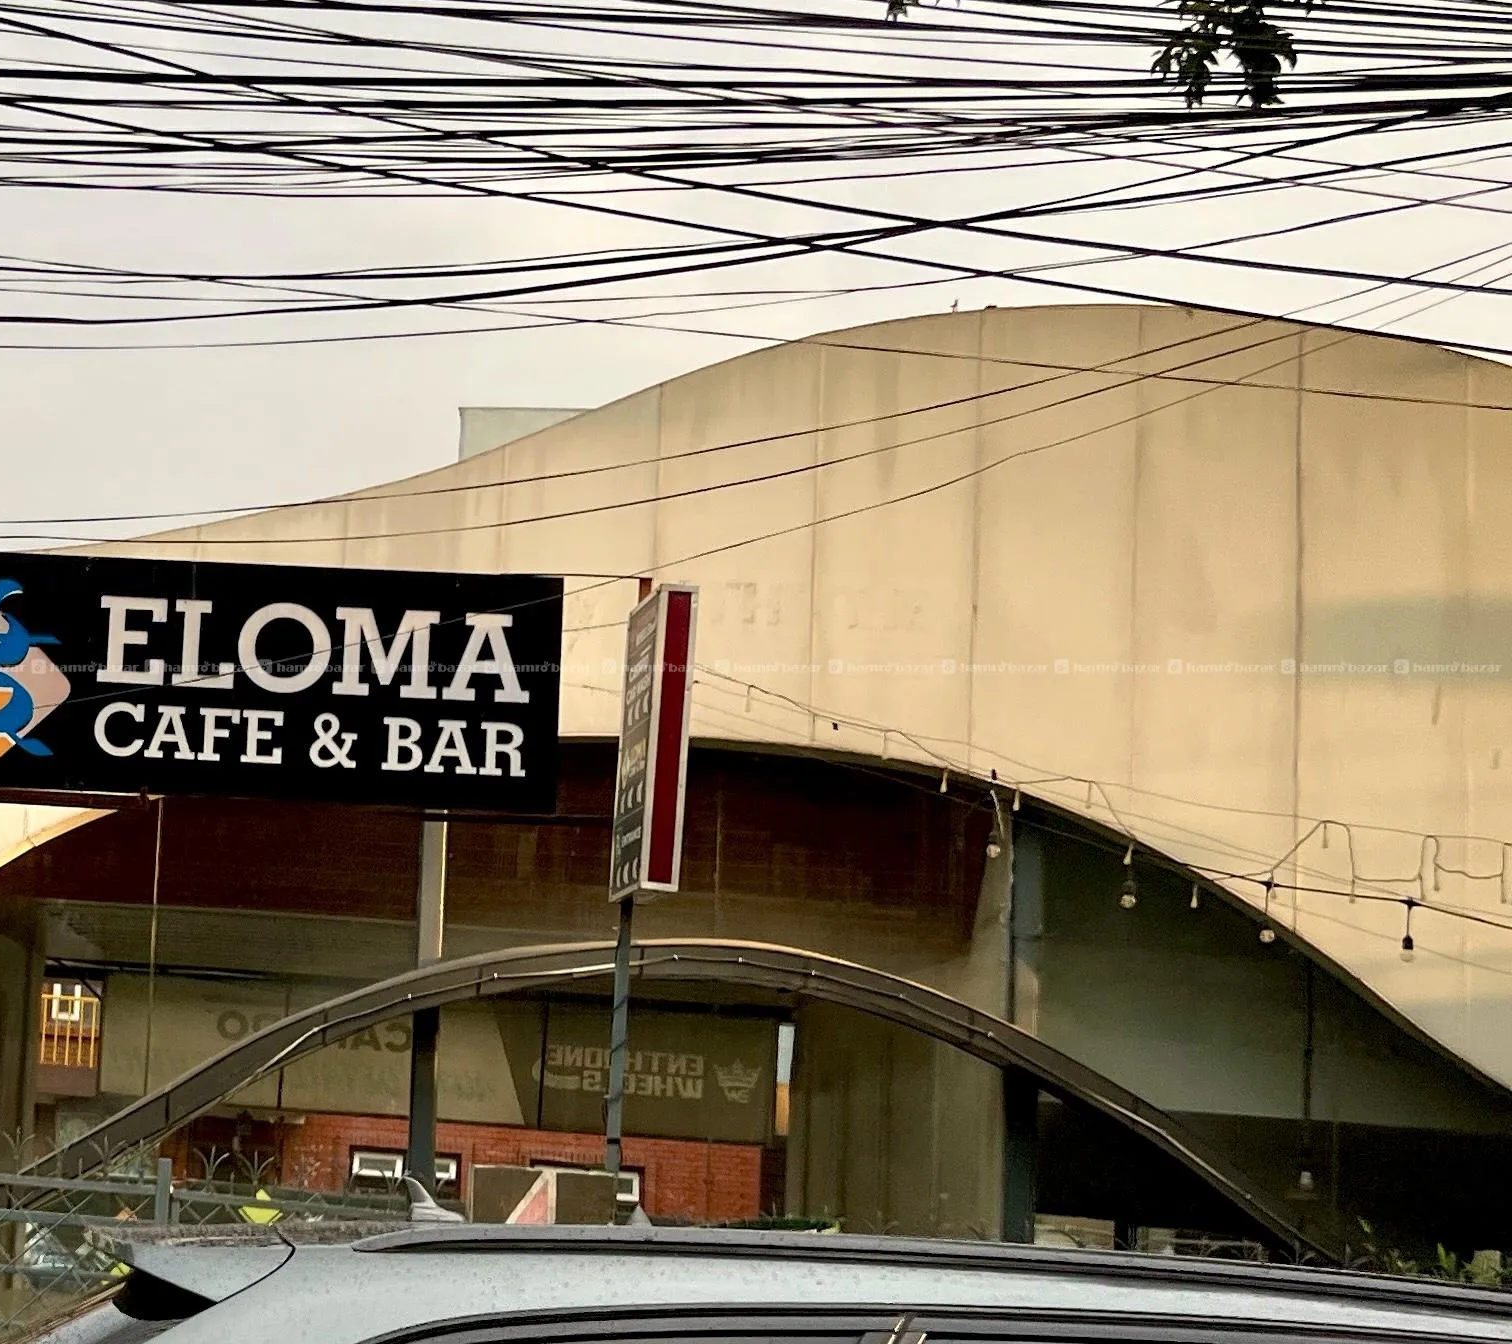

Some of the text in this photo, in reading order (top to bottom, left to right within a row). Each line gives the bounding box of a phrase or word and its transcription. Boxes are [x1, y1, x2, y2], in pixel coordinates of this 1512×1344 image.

[96, 594, 530, 704] ELOMA
[93, 701, 526, 777] CAFE & BAR
